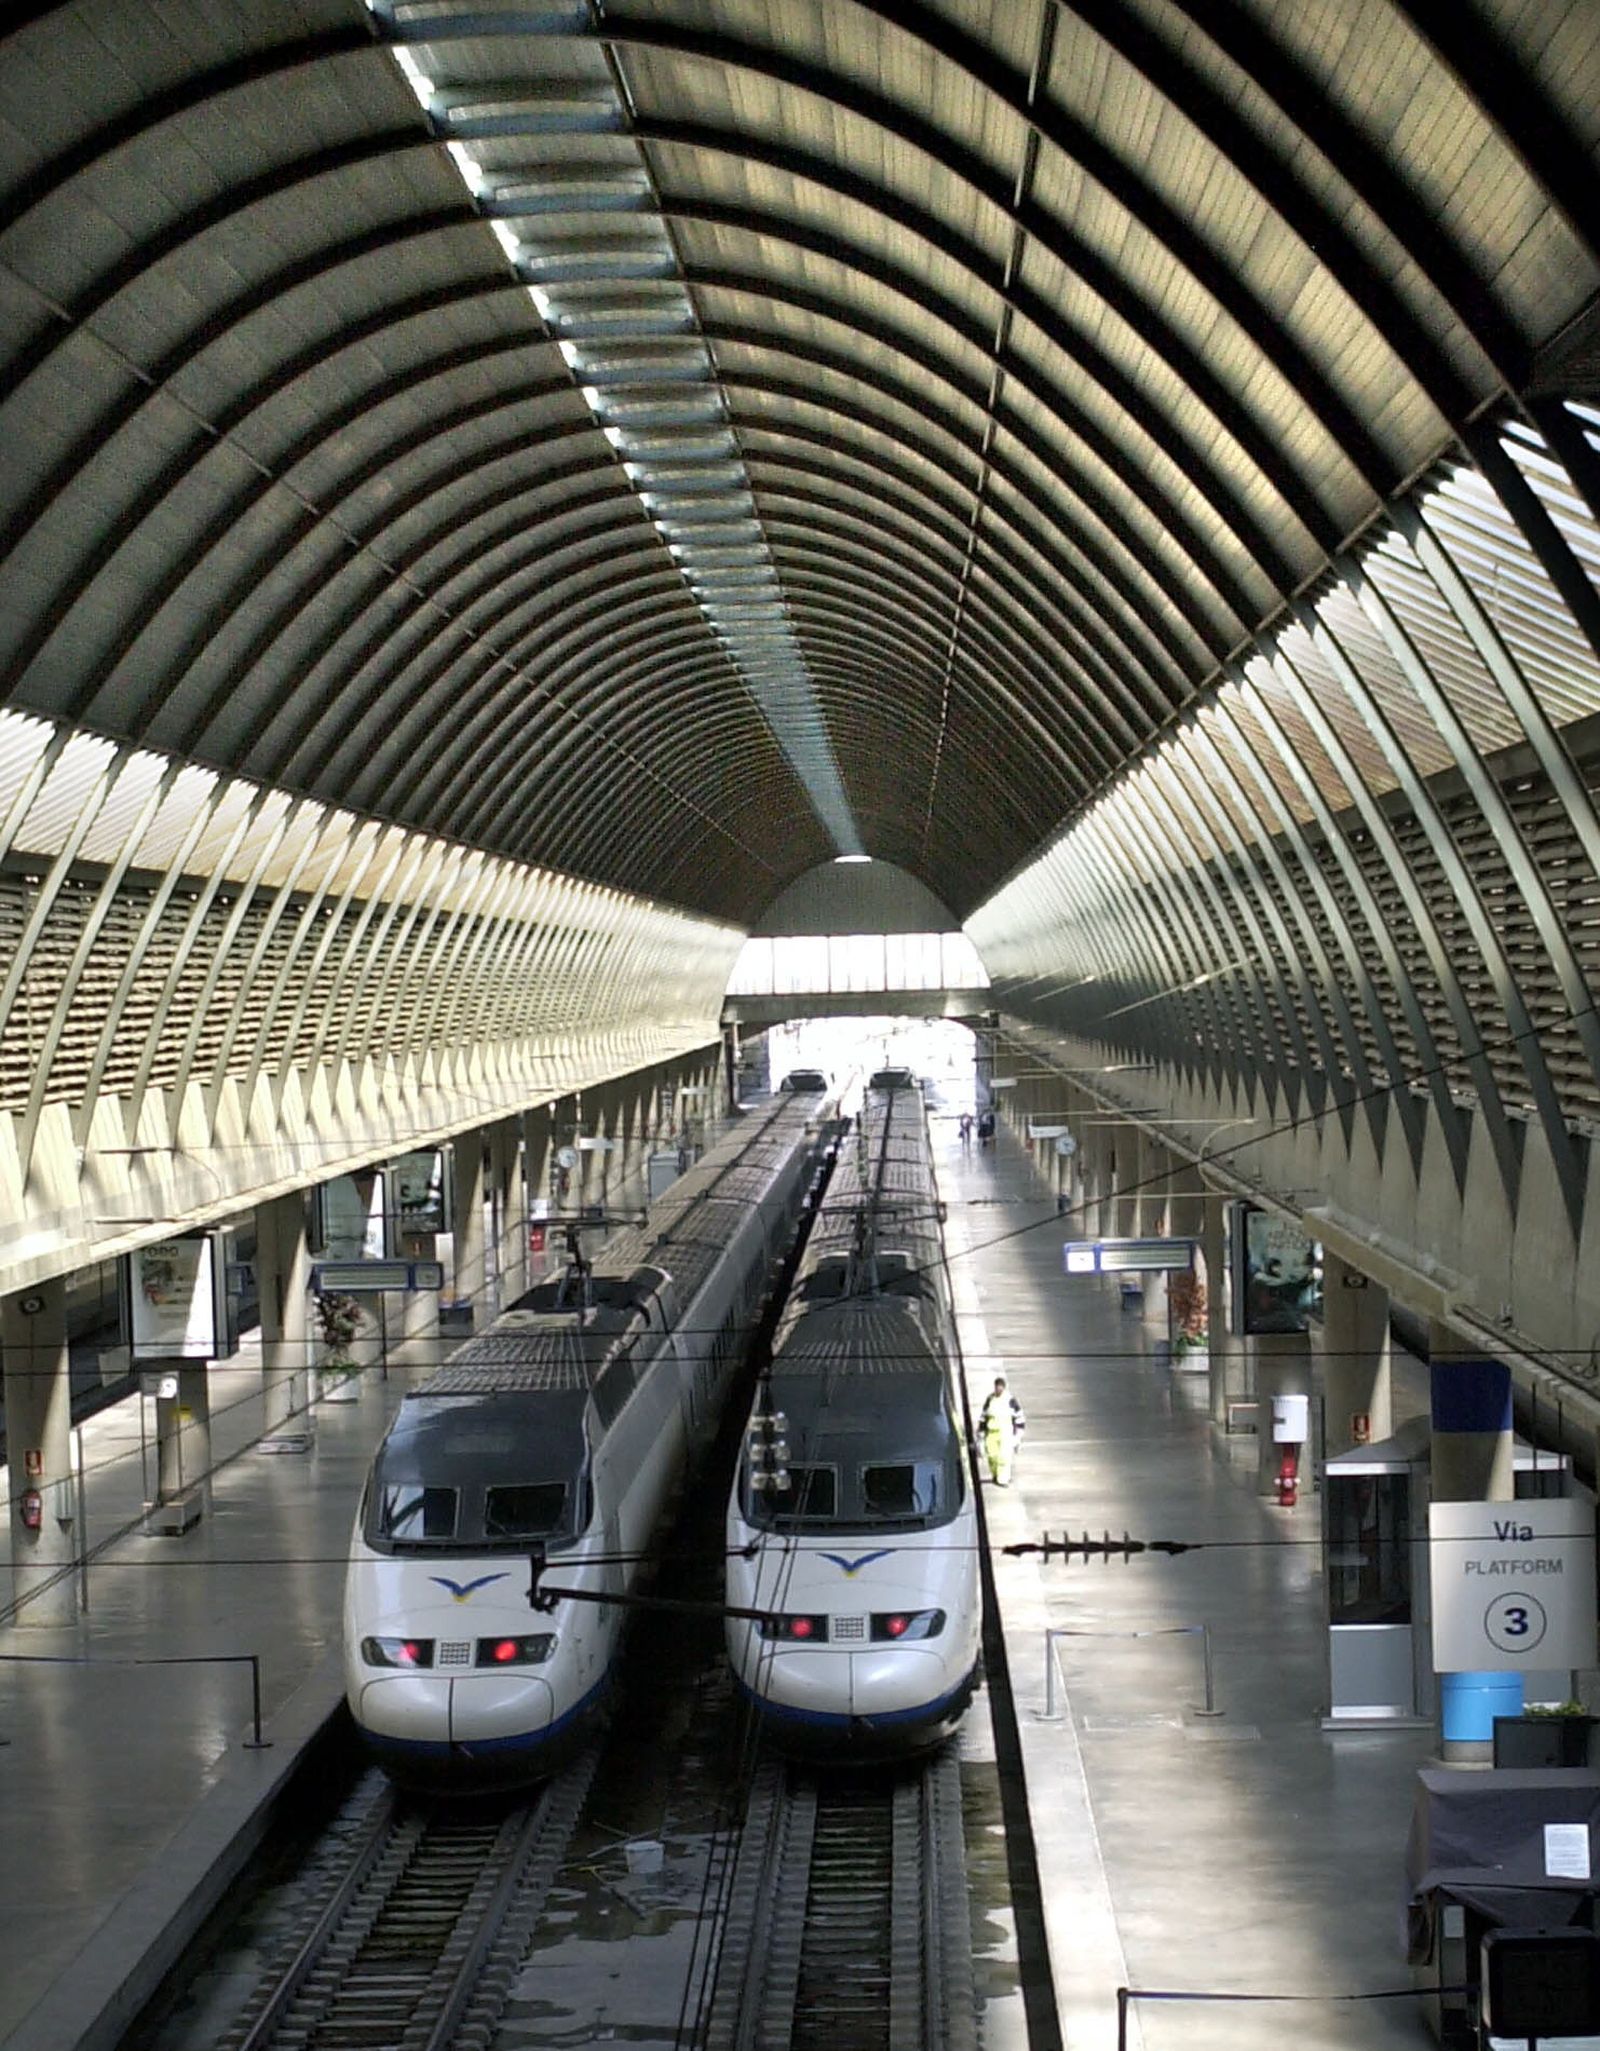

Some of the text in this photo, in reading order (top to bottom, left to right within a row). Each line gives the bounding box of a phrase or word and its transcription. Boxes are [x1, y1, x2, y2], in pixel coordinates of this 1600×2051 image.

[1494, 1520, 1533, 1541] Via
[1464, 1559, 1564, 1575] PLATFORM
[1504, 1607, 1529, 1636] 3
